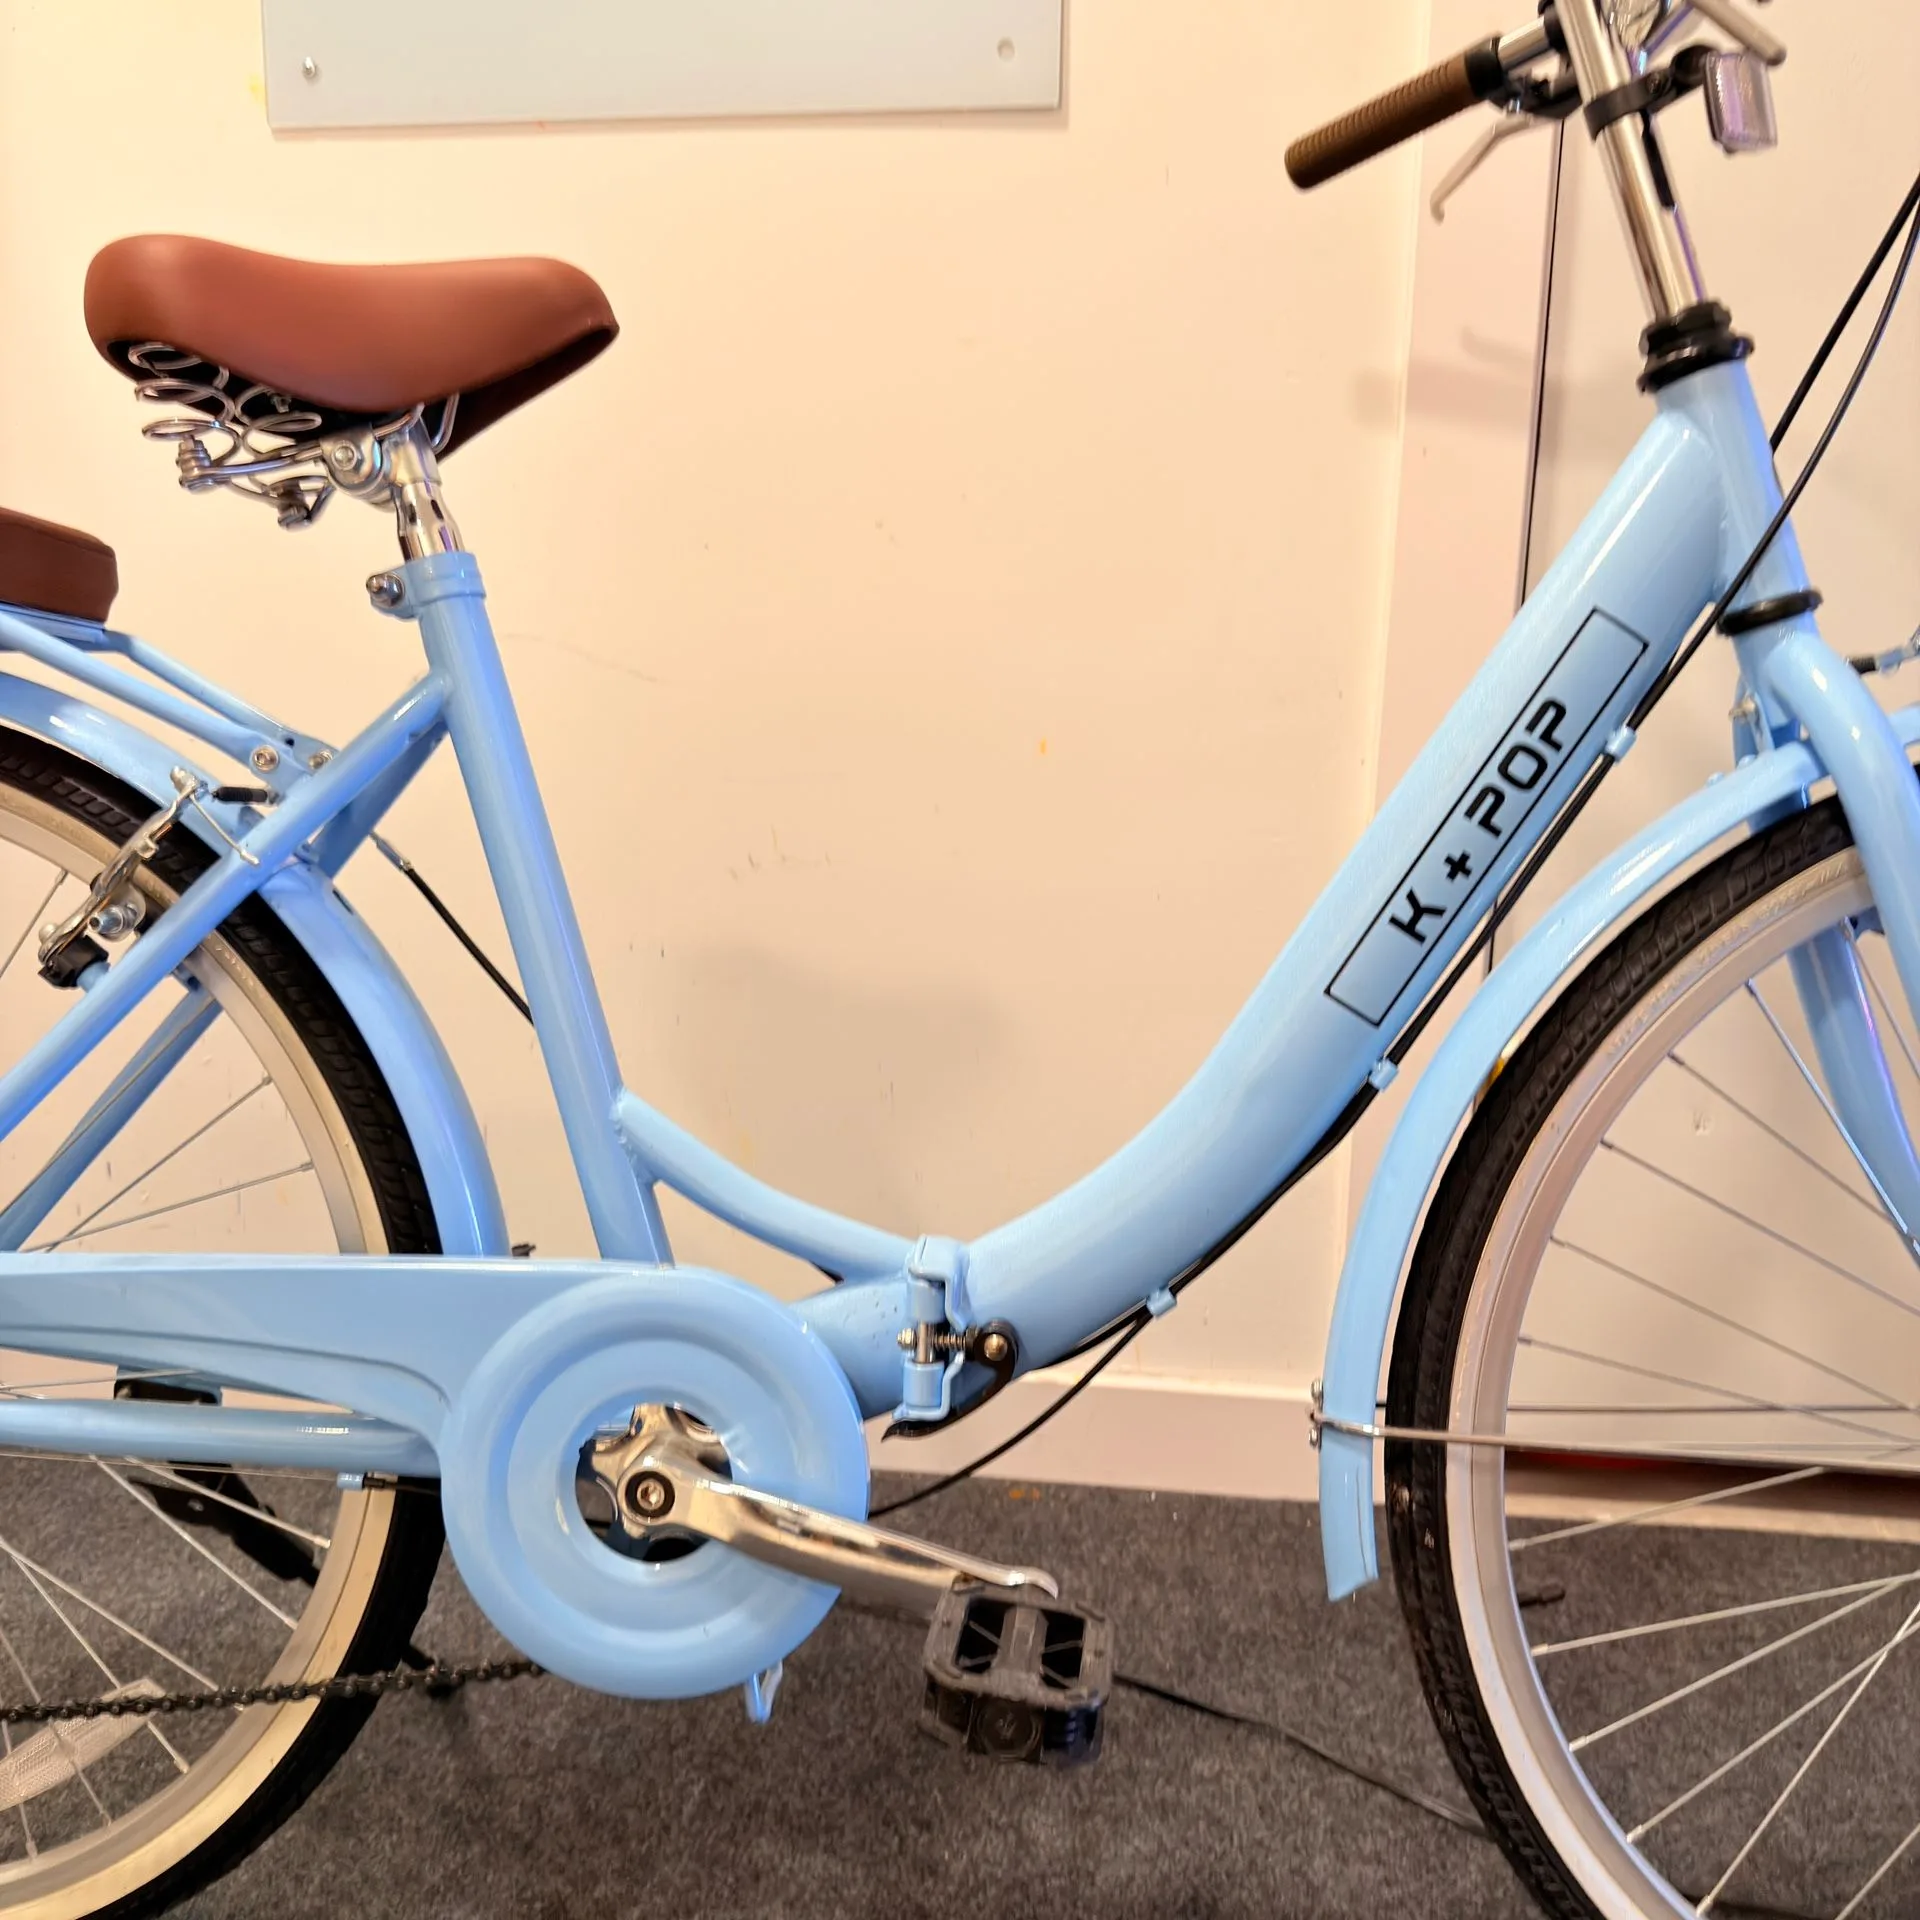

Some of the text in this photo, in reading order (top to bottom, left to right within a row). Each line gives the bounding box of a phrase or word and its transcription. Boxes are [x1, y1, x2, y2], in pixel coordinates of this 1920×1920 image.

[1389, 698, 1567, 944] K + POP
